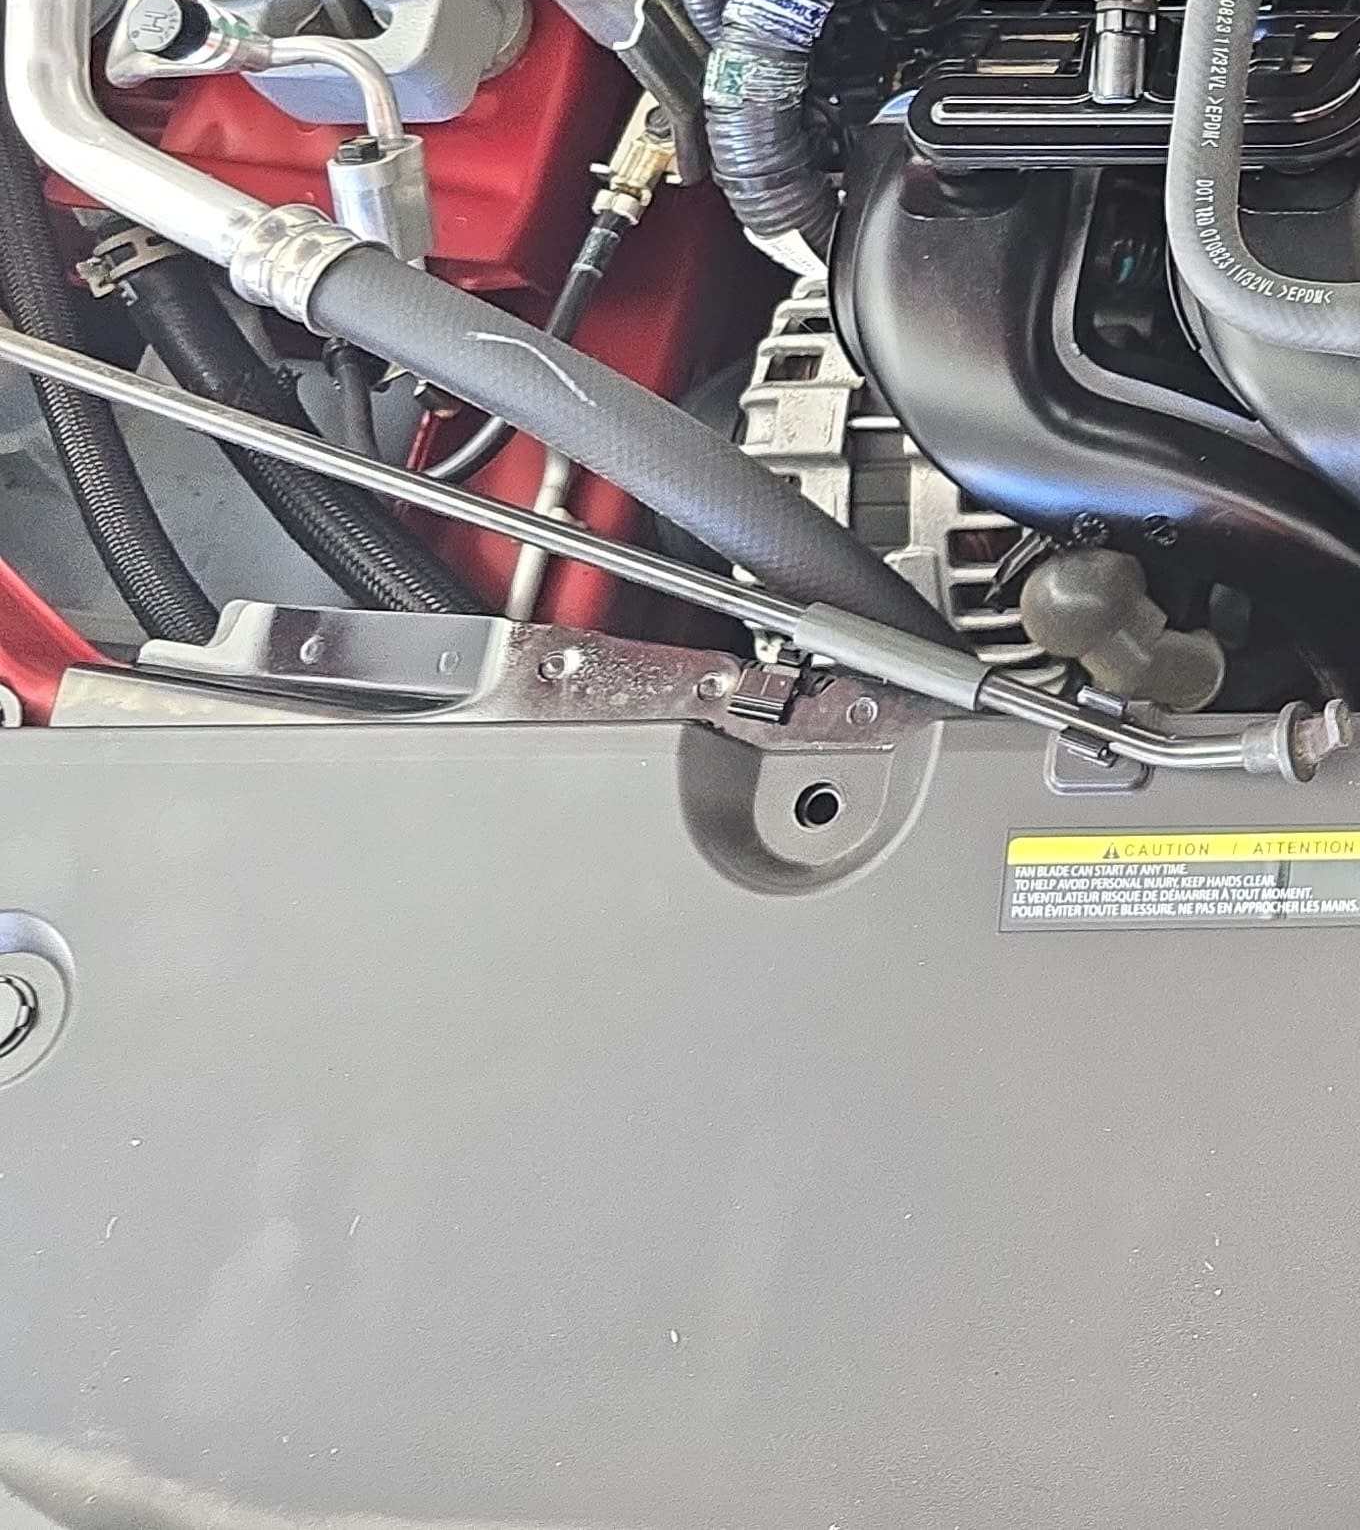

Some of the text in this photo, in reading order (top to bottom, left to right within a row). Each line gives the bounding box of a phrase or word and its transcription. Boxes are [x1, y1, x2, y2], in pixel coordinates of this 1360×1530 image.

[1195, 179, 1215, 203] DOT
[1200, 228, 1235, 270] 070823
[1124, 843, 1210, 857] CAUTION
[1253, 840, 1355, 855] ATTENTION
[1015, 866, 1036, 878] FAN
[1037, 865, 1070, 877] BLADE
[1071, 865, 1093, 877] CAN
[1094, 864, 1126, 876] START
[1125, 864, 1139, 876] AT
[1139, 864, 1163, 876] ANY
[1015, 879, 1030, 891] TO
[1031, 879, 1057, 891] HELP
[1057, 878, 1090, 890] AVOID
[1091, 877, 1142, 889] PERSONAL
[1143, 877, 1180, 890] INJURY,
[1181, 875, 1206, 888] KEEP
[1206, 875, 1242, 888] HANDS
[1013, 892, 1027, 905] LE
[1027, 891, 1100, 904] VENTILATEUR
[1101, 890, 1142, 903] RISQUE
[1143, 890, 1159, 902] DE
[1159, 888, 1219, 901] DÉMARRER
[1230, 888, 1260, 900] TOUT
[1262, 887, 1313, 900] MOMENT.
[1011, 899, 1360, 918] POUR ÉVITER TOUTE BLESSURE, NE PAS EN APPROCHER LES MAINS.
